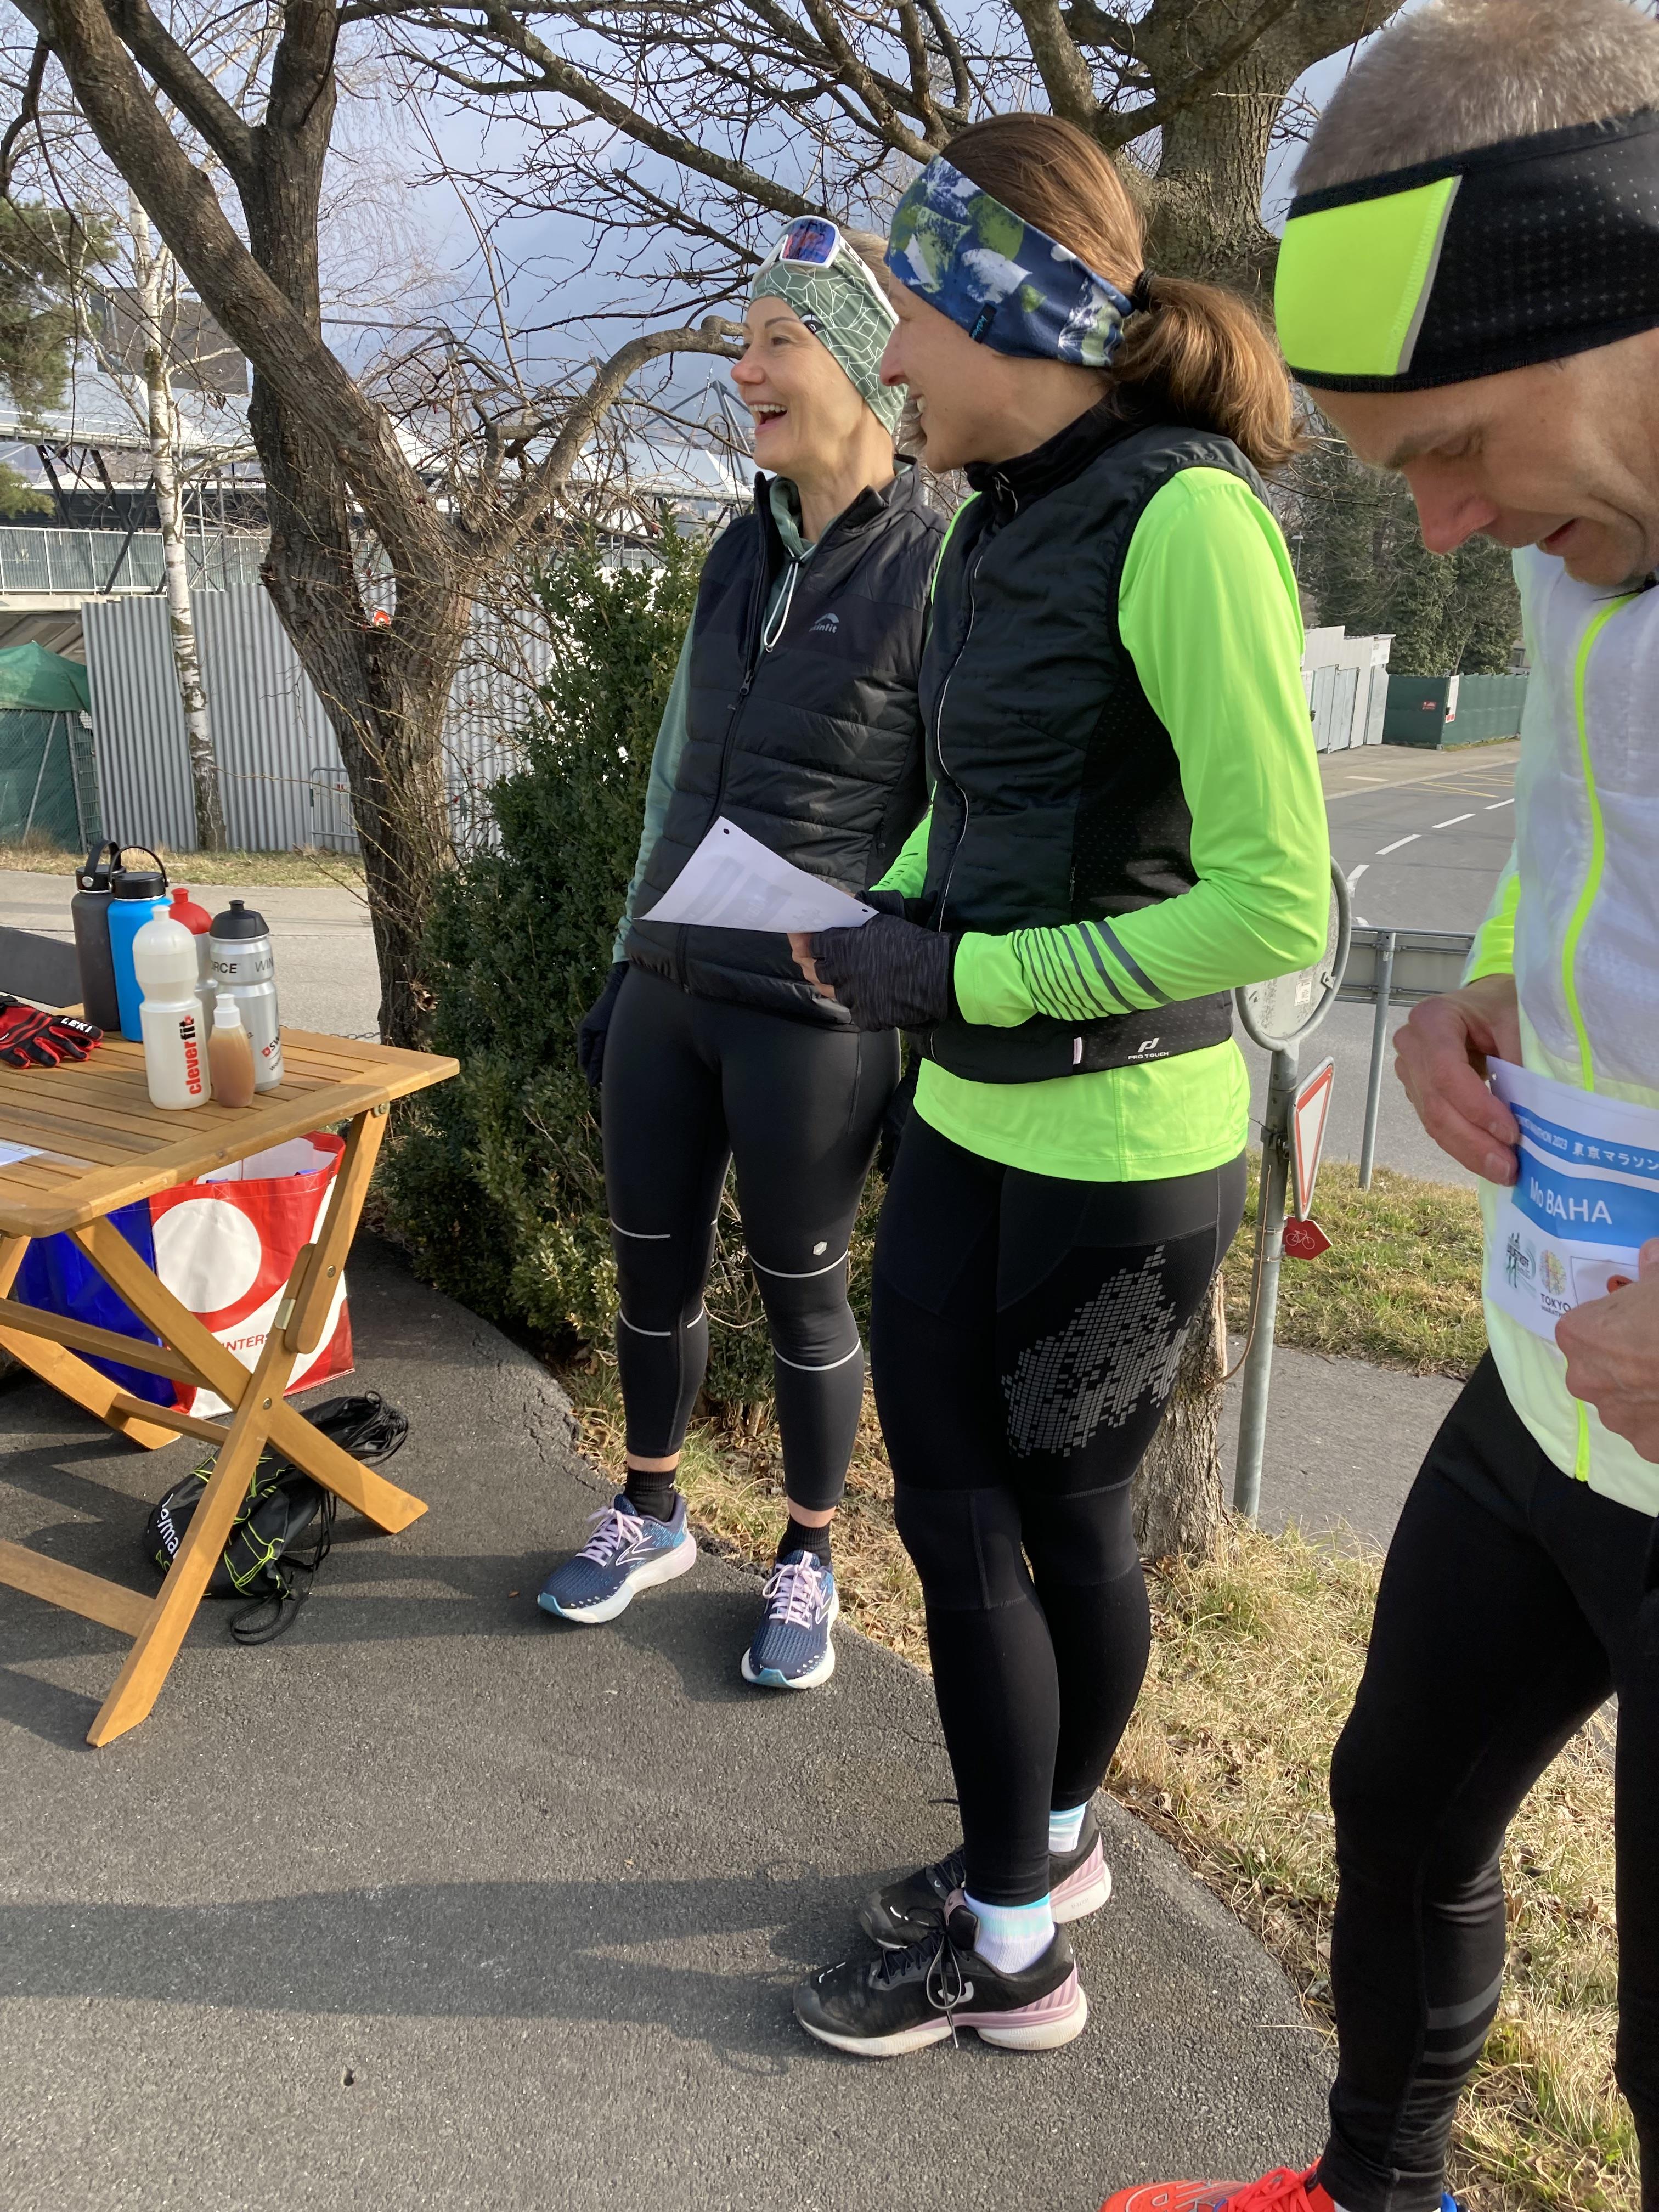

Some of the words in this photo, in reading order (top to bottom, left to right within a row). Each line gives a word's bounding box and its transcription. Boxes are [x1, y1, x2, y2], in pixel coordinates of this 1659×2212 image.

[60, 1017, 93, 1033] LEKI
[179, 1018, 196, 1040] fit
[185, 1040, 202, 1095] clever
[1530, 1177, 1544, 1207] Mo
[1545, 1189, 1613, 1224] BAHA
[1541, 1293, 1571, 1312] TOKYO
[222, 1334, 267, 1351] NTER
